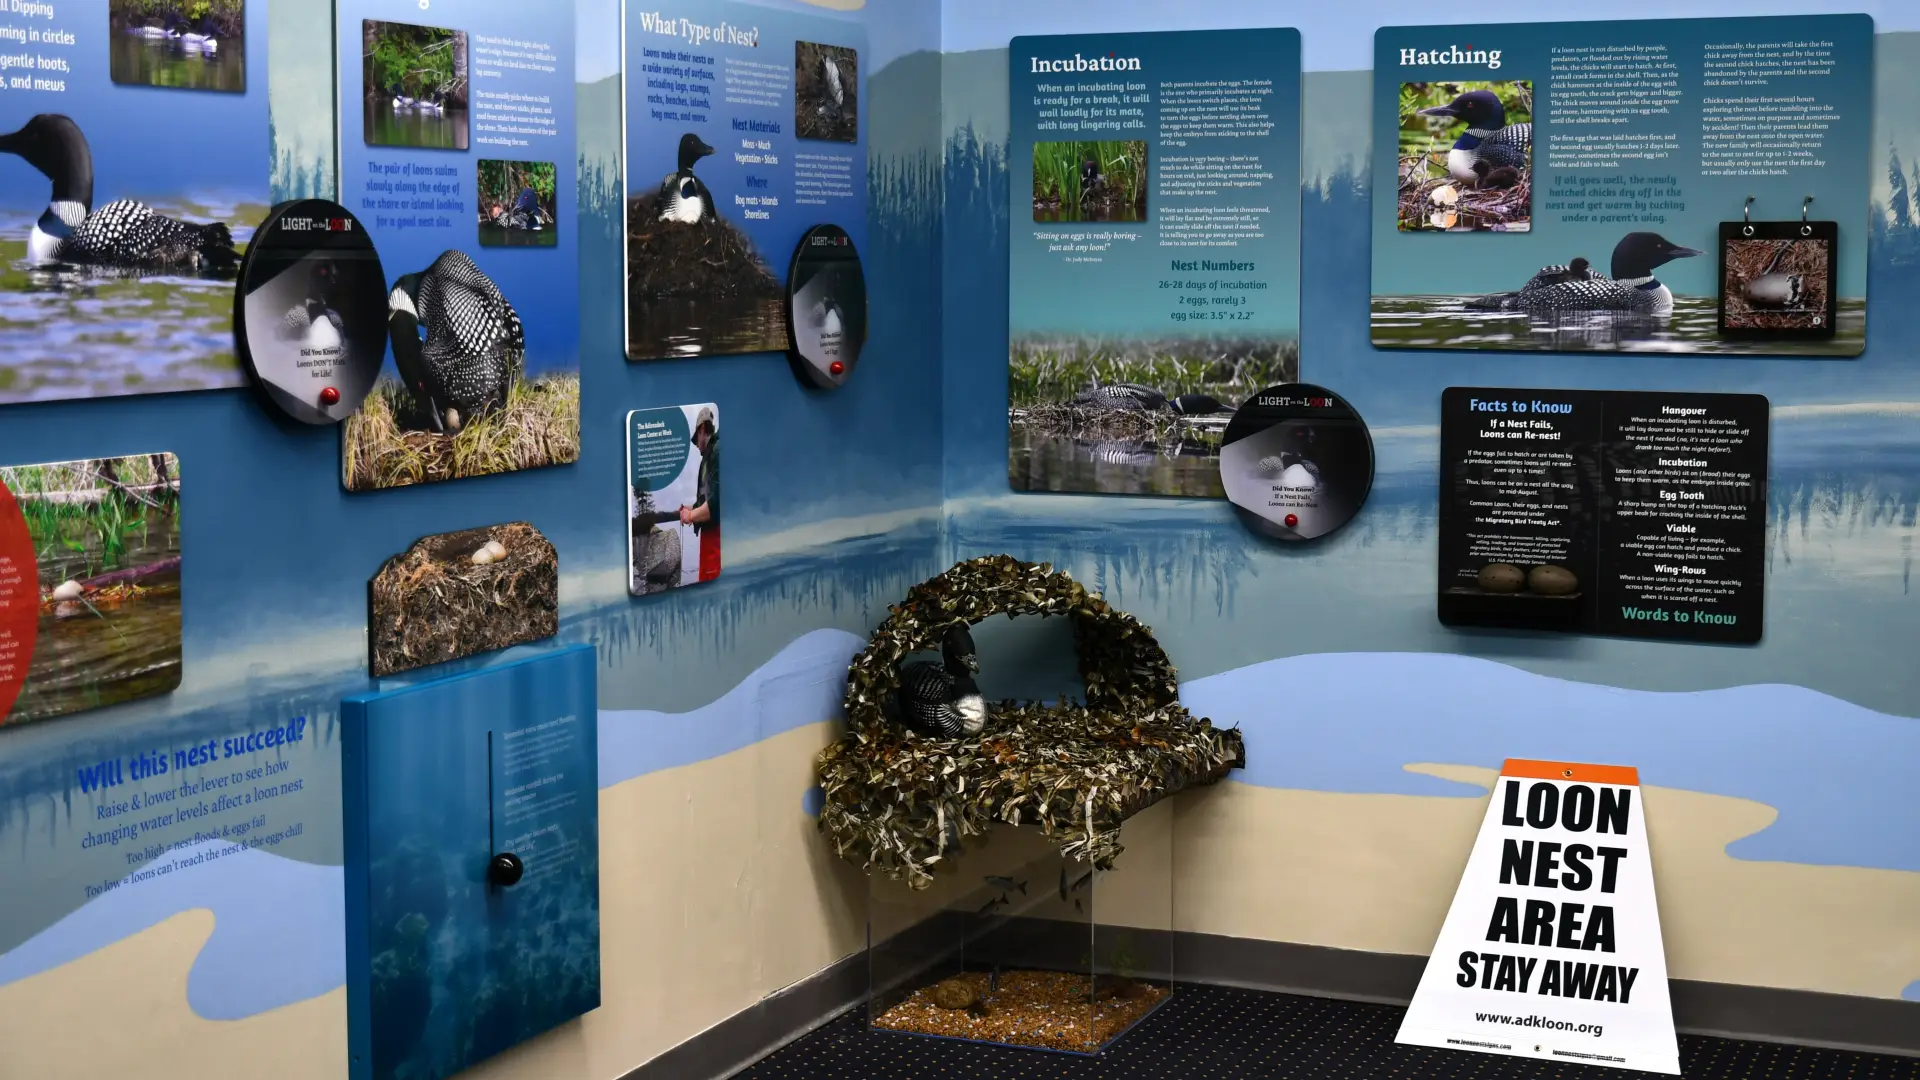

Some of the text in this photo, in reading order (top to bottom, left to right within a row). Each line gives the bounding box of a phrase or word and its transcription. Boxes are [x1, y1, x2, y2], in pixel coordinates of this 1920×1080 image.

[12, 0, 53, 19] Dipping
[640, 12, 758, 47] What Type of Nest?
[30, 27, 39, 41] in
[43, 29, 75, 45] circles
[644, 47, 660, 58] Loons
[661, 50, 676, 60] make
[678, 52, 691, 62] their
[692, 56, 706, 64] nests
[1400, 45, 1501, 69] Hatching
[1, 54, 69, 73] gentle hoots,
[1031, 52, 1141, 72] Incubation
[11, 75, 31, 89] and
[35, 80, 65, 91] mews
[1078, 82, 1124, 92] incubating
[1127, 82, 1146, 90] loon
[733, 118, 780, 133] Nest Materials
[743, 139, 771, 150] Moss Muck
[735, 153, 778, 164] Vegetation Sticks
[368, 162, 457, 177] The pair of loons swims
[747, 176, 767, 188] Where
[736, 195, 745, 207] Bog
[762, 196, 778, 205] Islands
[745, 210, 769, 219] Shorelines
[282, 218, 313, 230] LIGHT
[325, 219, 352, 230] LOON
[1094, 232, 1112, 241] really
[1114, 232, 1136, 241] boring
[1049, 244, 1062, 252] just
[1172, 260, 1254, 271] Nest Numbers
[1186, 280, 1206, 291] days
[1209, 280, 1218, 291] of
[1221, 280, 1267, 289] incubation
[1187, 298, 1208, 306] eggs,
[1212, 296, 1238, 306] rarely
[1171, 313, 1186, 321] egg
[1189, 311, 1207, 319] size:
[1259, 397, 1290, 406] LIGHT
[1304, 398, 1332, 406] LOON
[1471, 399, 1572, 413] Facts to Know
[1662, 406, 1706, 416] Hangover
[1491, 419, 1497, 429] If
[1530, 420, 1553, 430] Fails,
[1481, 430, 1504, 438] Loons
[1525, 431, 1560, 440] Re-nest!
[1659, 458, 1707, 467] Incubation
[1660, 491, 1704, 501] Egg Tooth
[1667, 524, 1696, 533] Viable
[1654, 565, 1706, 575] Wing-Rows
[1622, 607, 1736, 624] Words to Know
[78, 716, 306, 793] Will this nest succeed?
[97, 759, 289, 820] Raise & lower the lever to see how
[82, 779, 303, 849] changing water levels affect a loon nest
[1502, 781, 1631, 835] LOON
[1499, 839, 1627, 894] NEST
[1486, 897, 1616, 952] AREA
[1456, 951, 1638, 1004] STAY AWAY
[1476, 1013, 1602, 1037] www.adkloon.org
